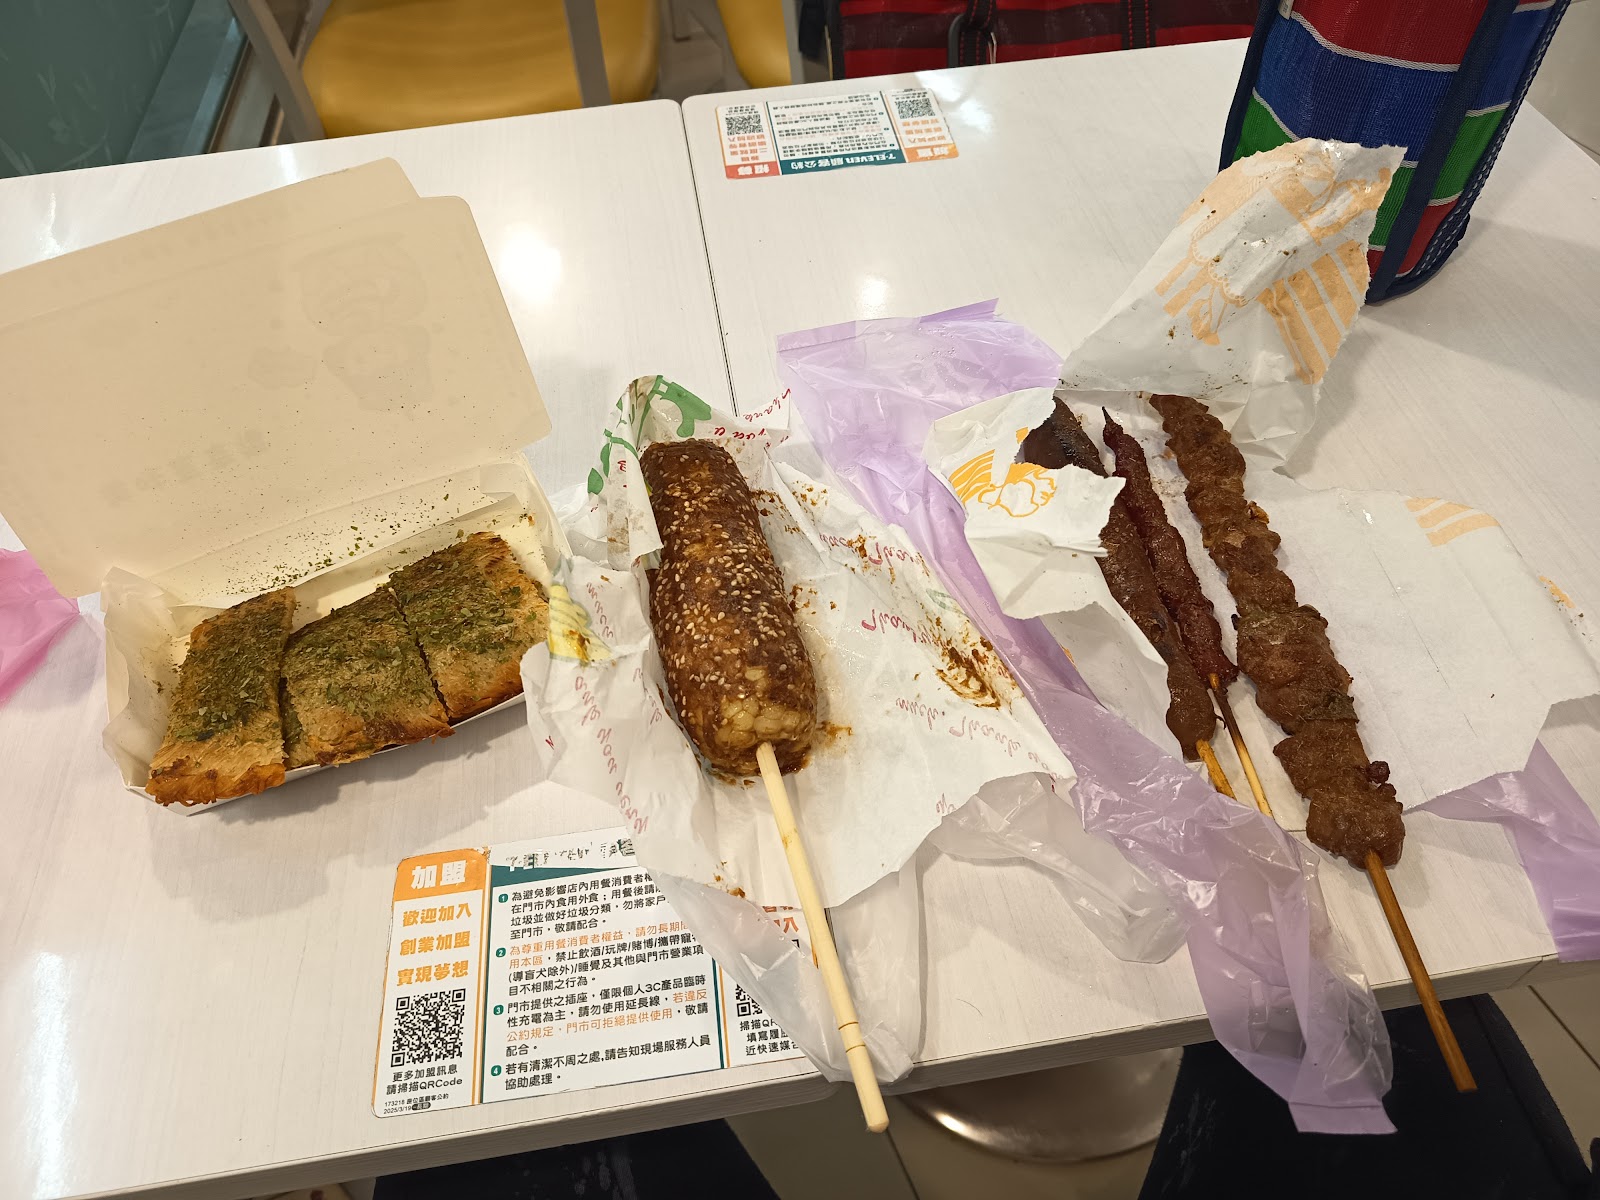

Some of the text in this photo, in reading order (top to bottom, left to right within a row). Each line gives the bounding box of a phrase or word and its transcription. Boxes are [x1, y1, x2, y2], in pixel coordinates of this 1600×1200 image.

[790, 157, 844, 170] 顧客公約
[411, 859, 467, 889] 加盟
[510, 895, 669, 927] 垃圾並做好垃圾分類，勿將家戶
[511, 884, 661, 914] 在門市內食用外食；用餐後請
[402, 903, 472, 927] 歡迎加入
[399, 931, 471, 956] 創業加盟
[396, 960, 469, 987] 實現夢想
[392, 1064, 458, 1082] 更多加盟訊息
[386, 1078, 463, 1095] 請掃描QRCode
